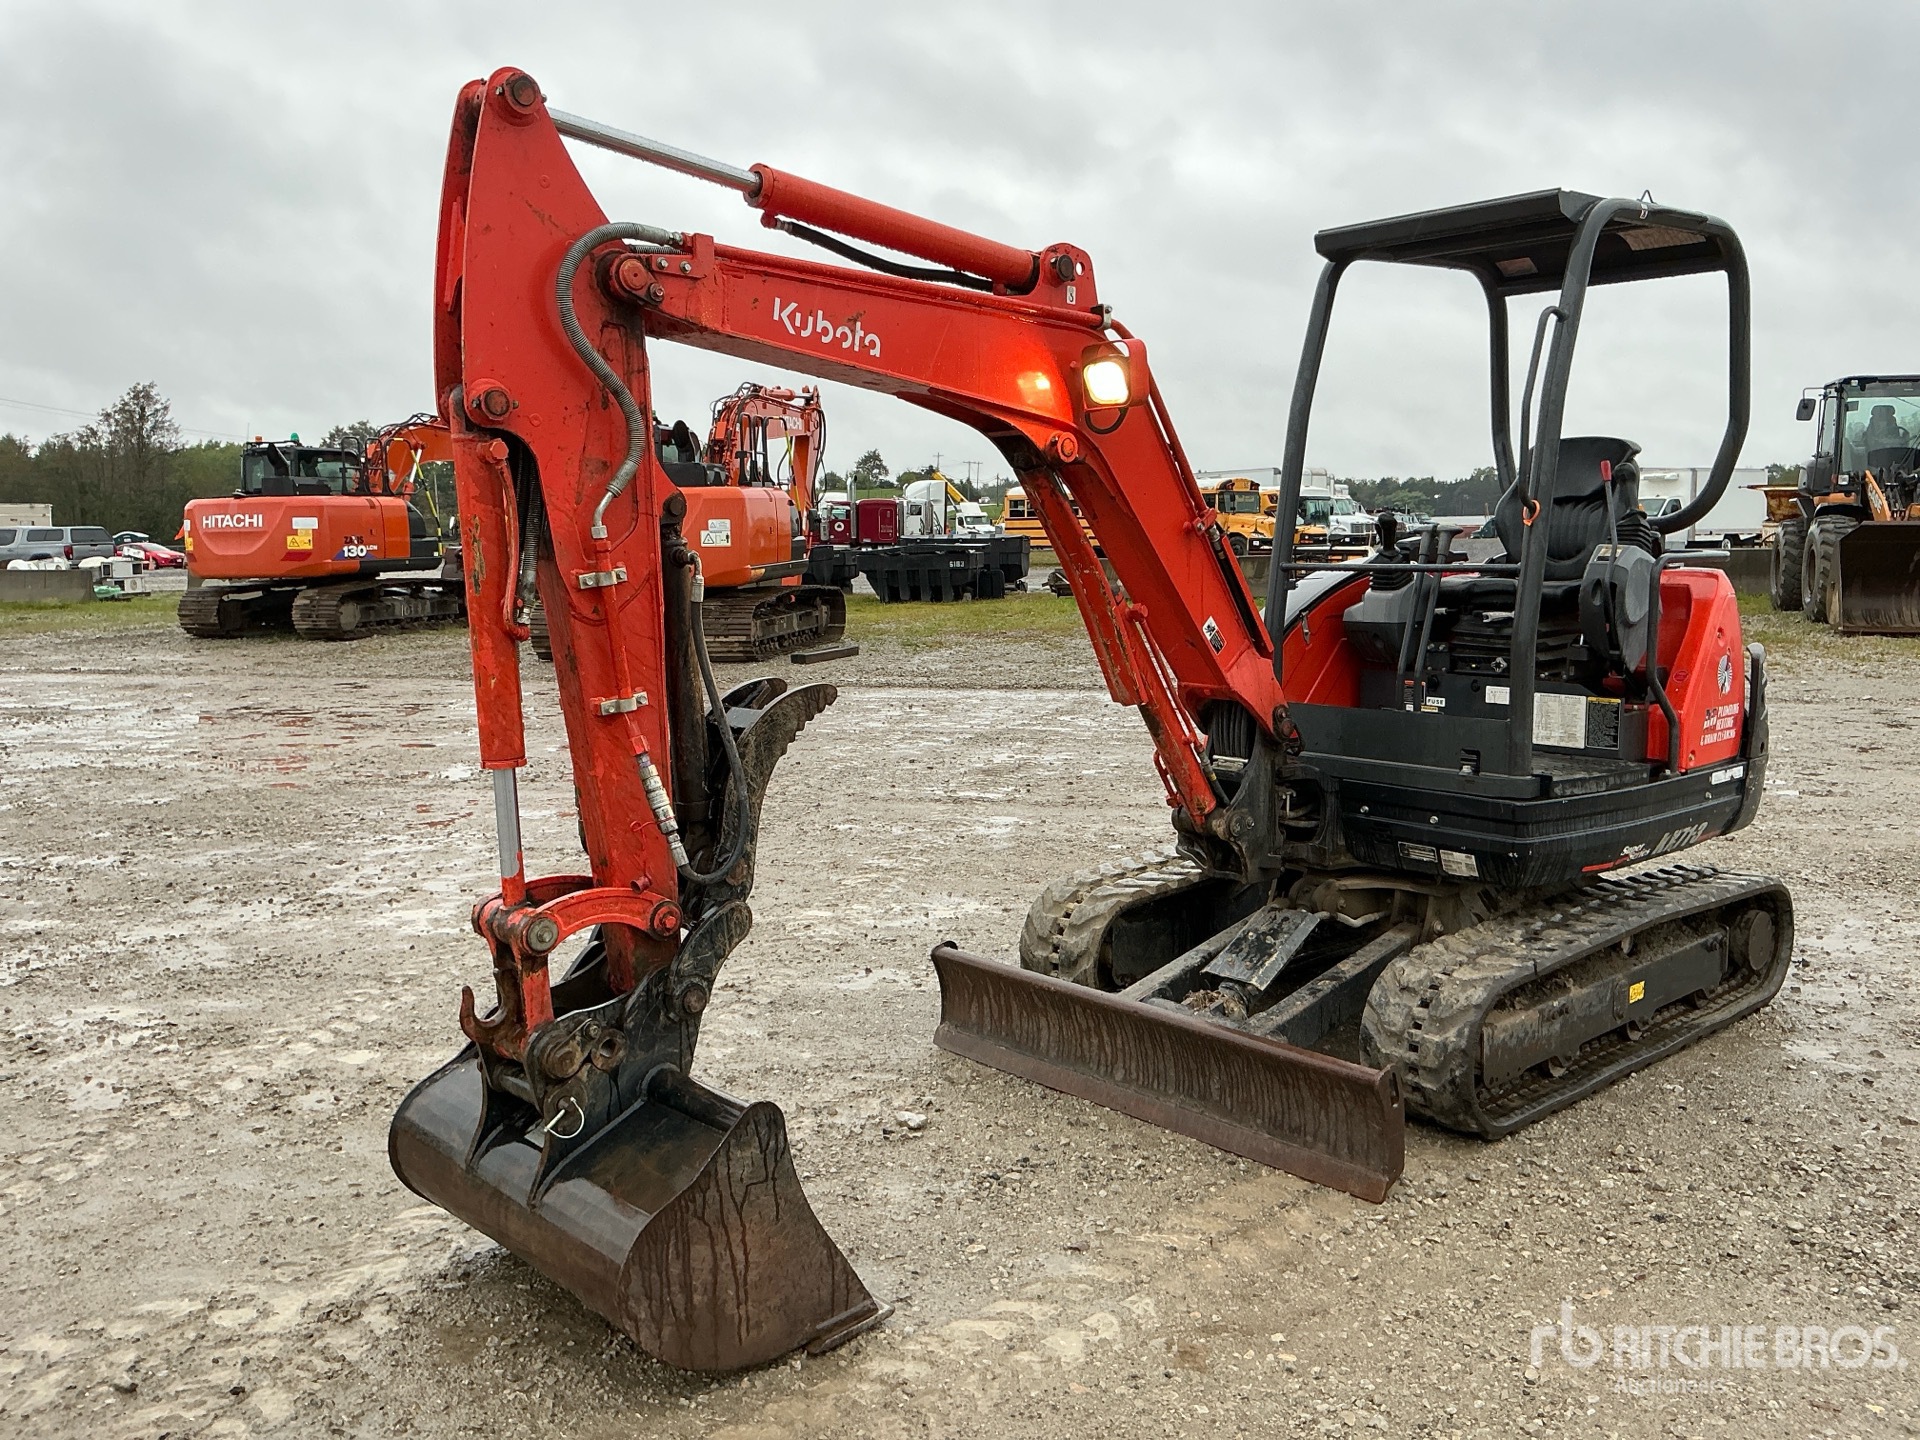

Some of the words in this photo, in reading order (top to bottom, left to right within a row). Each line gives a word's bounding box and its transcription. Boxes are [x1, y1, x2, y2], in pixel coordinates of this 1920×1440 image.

[772, 296, 881, 358] Kubota
[202, 513, 263, 529] HITACHI
[342, 544, 367, 558] 130
